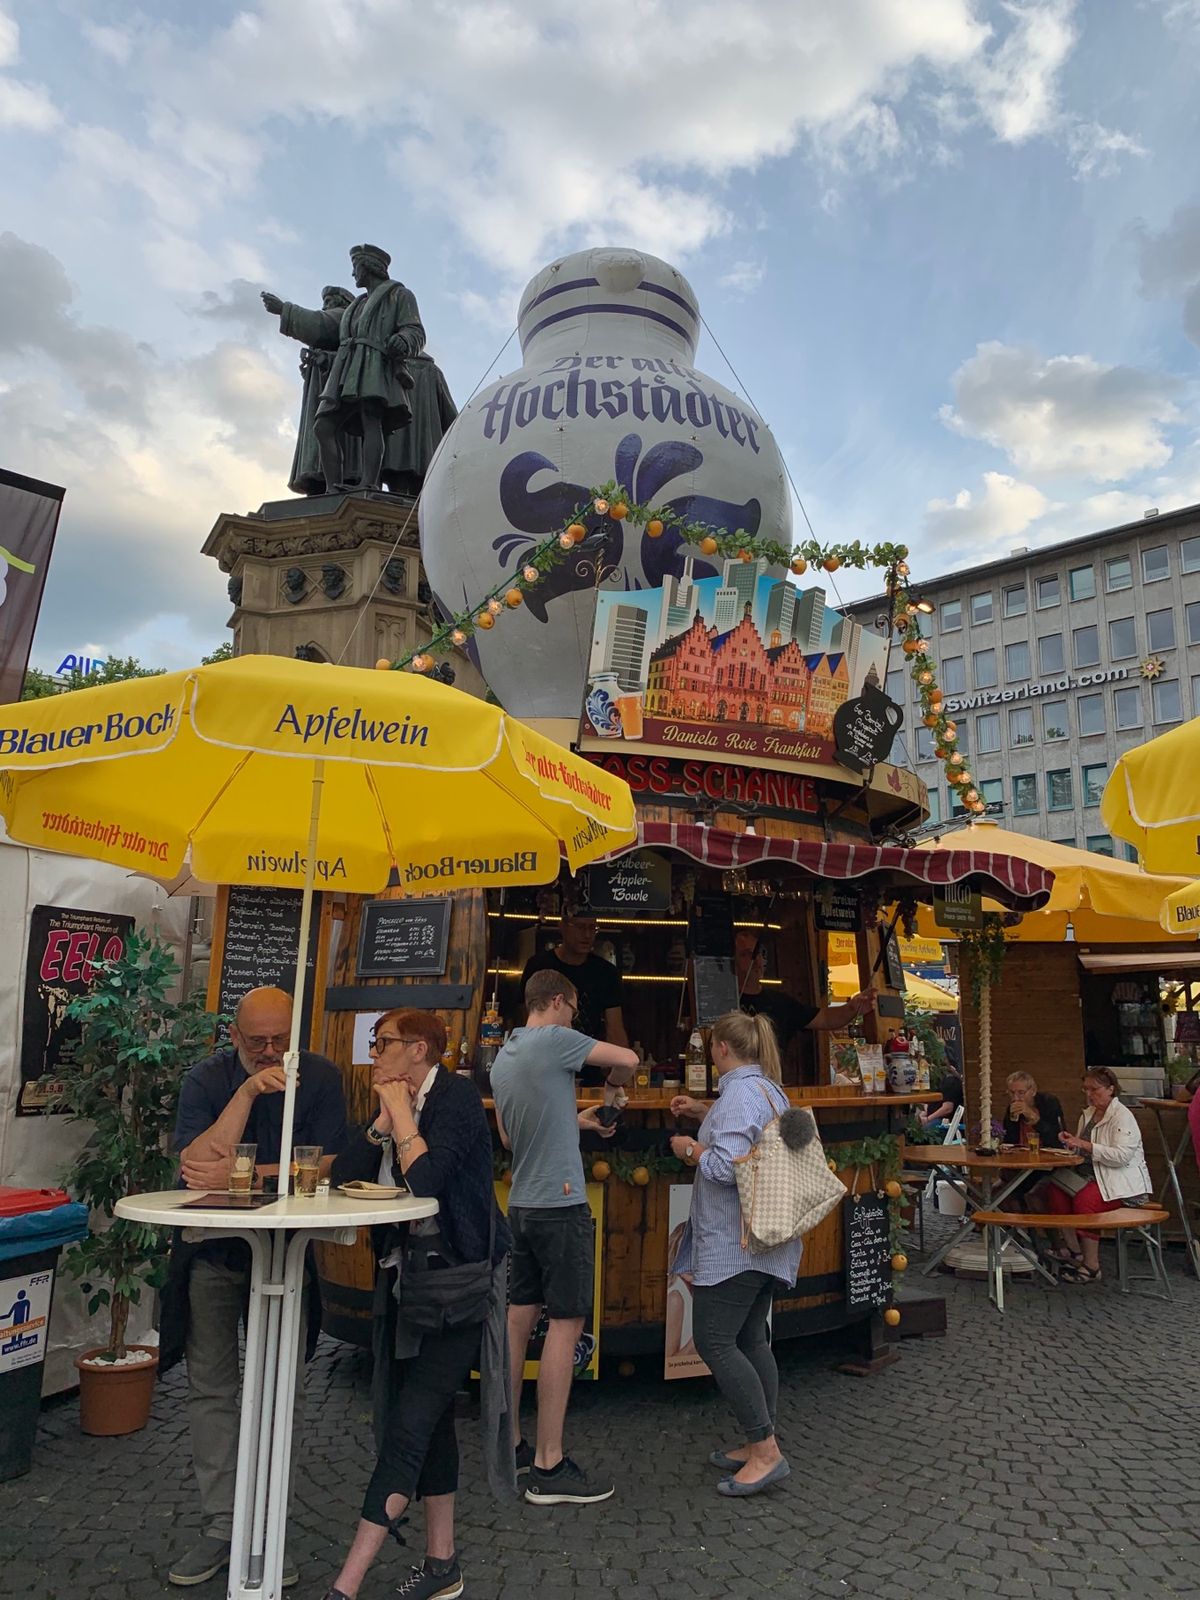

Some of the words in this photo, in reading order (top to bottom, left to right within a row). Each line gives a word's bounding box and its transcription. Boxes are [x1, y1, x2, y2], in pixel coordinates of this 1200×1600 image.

[275, 704, 429, 746] Apfelwein
[662, 725, 719, 747] Daniela
[612, 888, 649, 902] Bowle
[49, 919, 61, 927] The
[62, 920, 94, 931] Triumphant
[94, 923, 112, 933] Return
[112, 926, 119, 934] of
